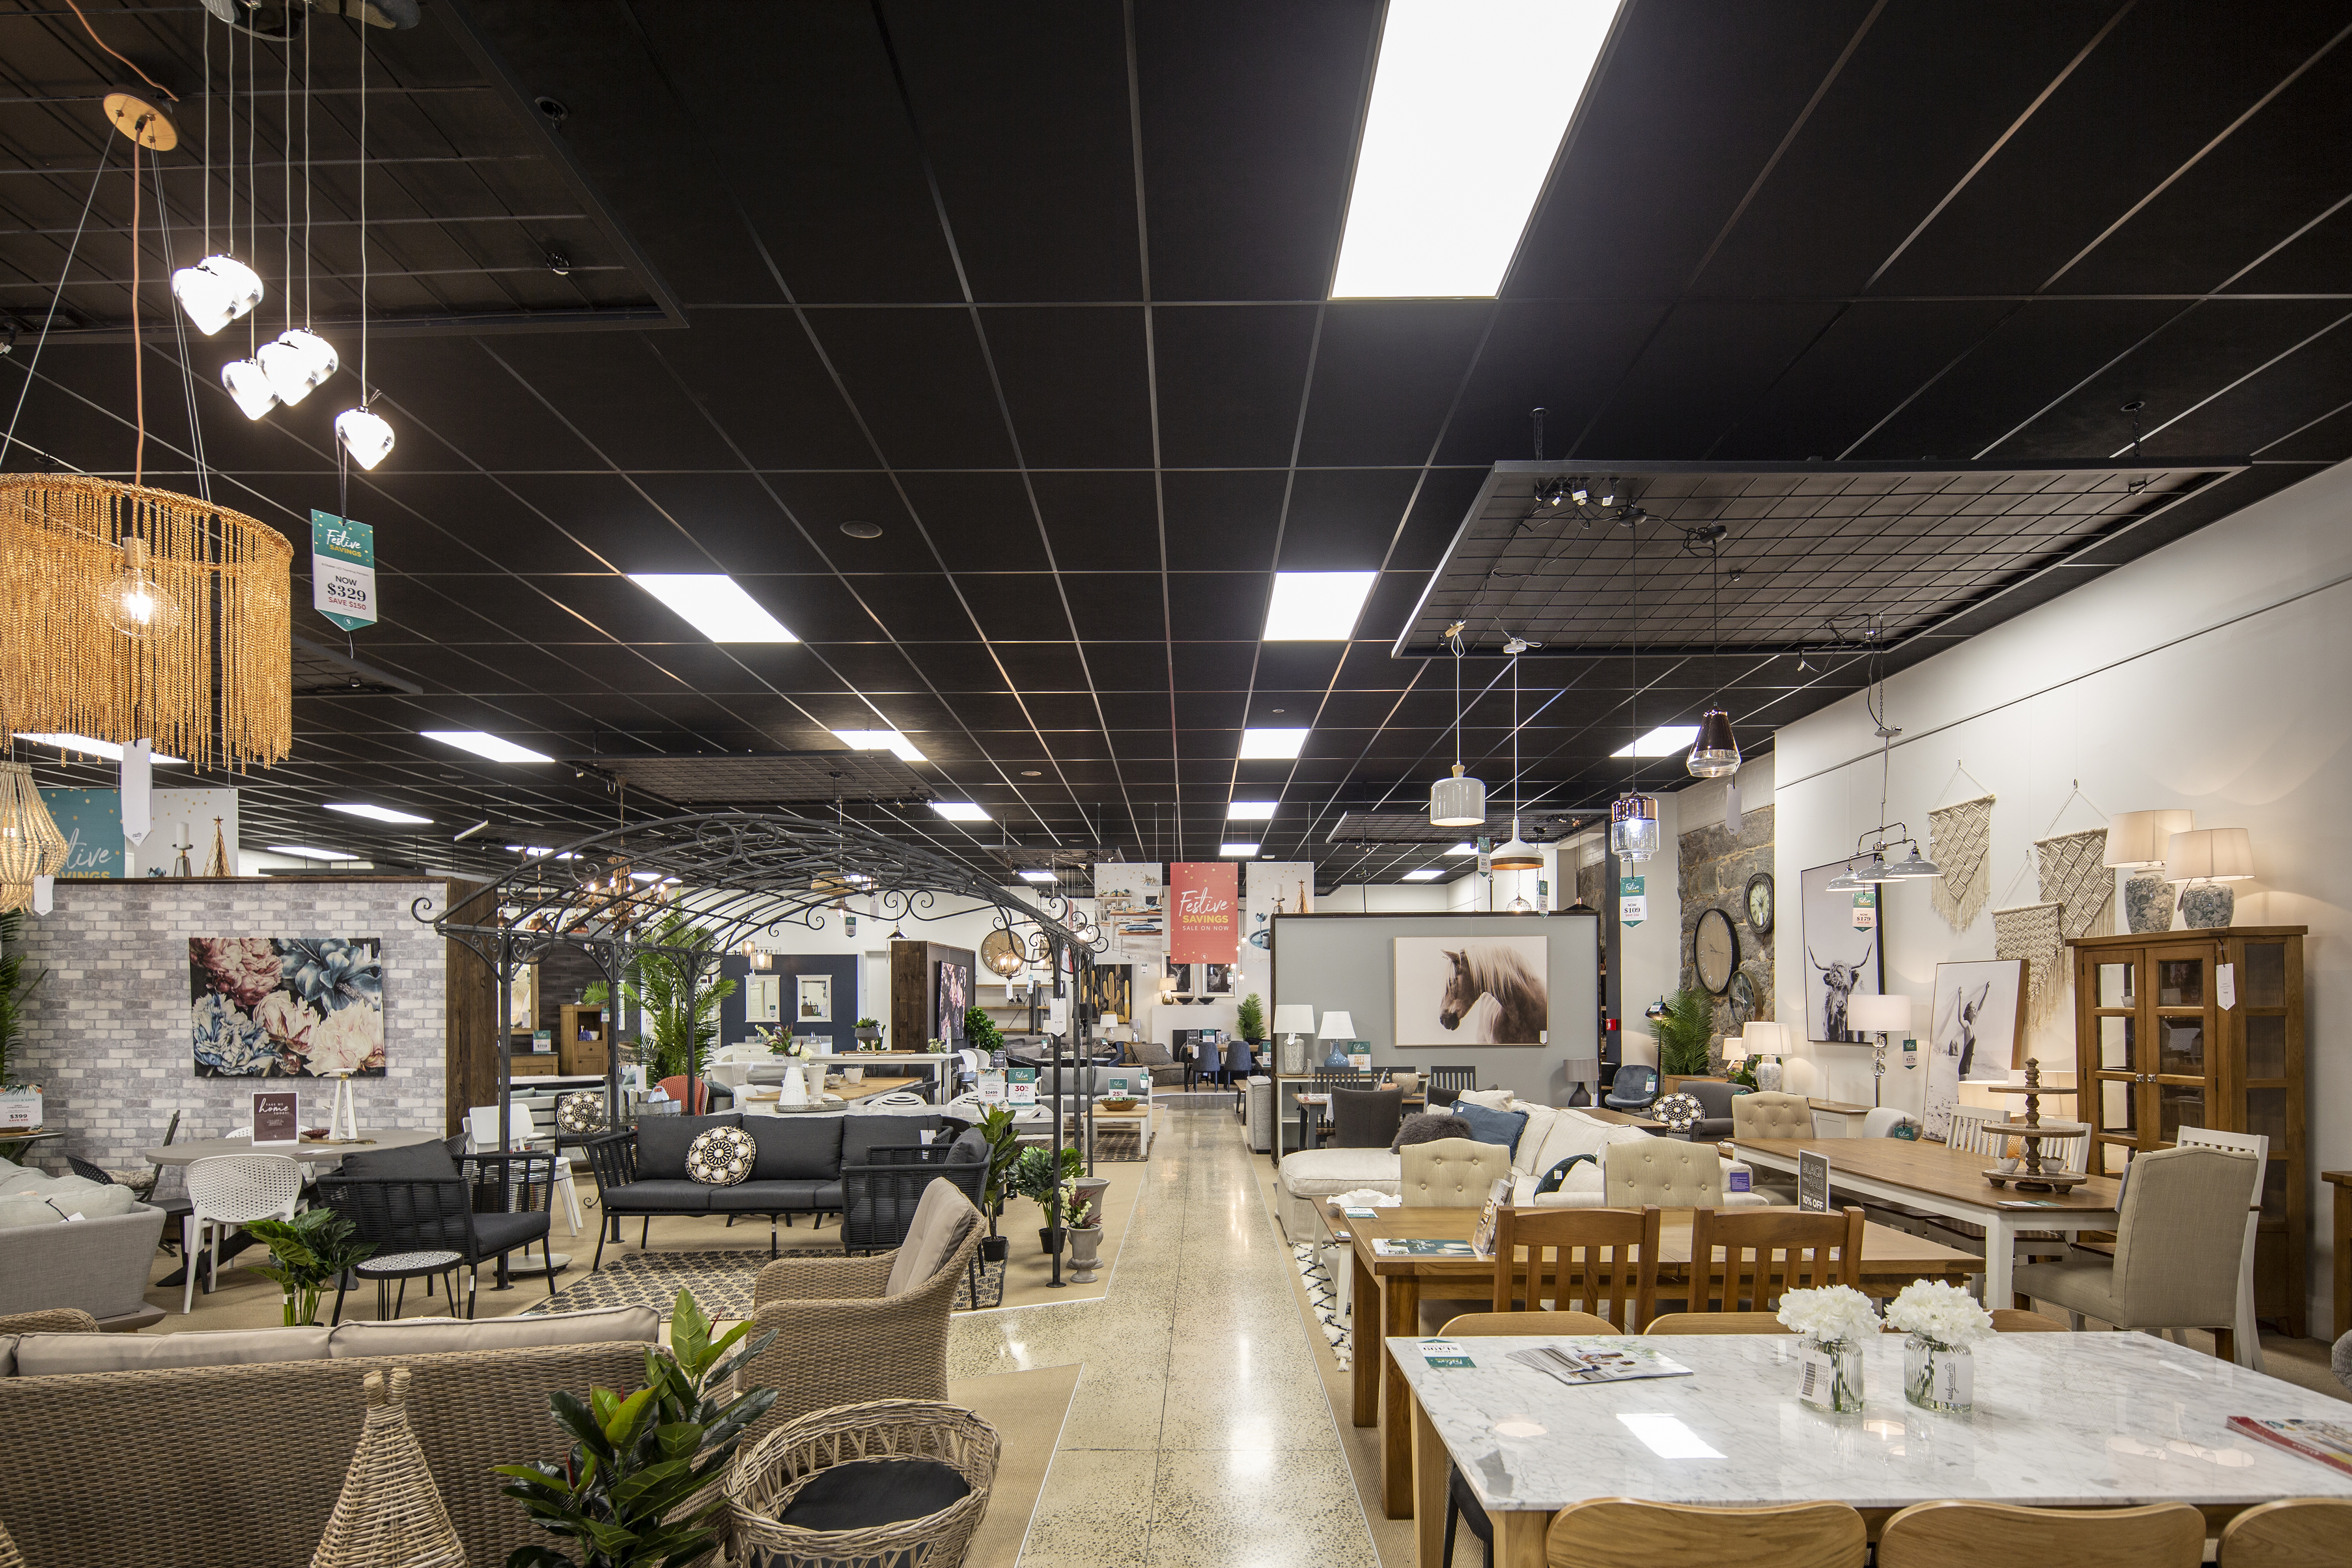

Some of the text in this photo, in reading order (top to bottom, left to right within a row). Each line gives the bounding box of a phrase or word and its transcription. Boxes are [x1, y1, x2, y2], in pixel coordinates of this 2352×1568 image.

[326, 529, 362, 549] Festive
[329, 544, 362, 557] SAVINGS
[336, 575, 357, 586] NOW
[327, 582, 366, 602] $329
[328, 597, 347, 606] SAVE
[349, 601, 366, 610] $150
[66, 828, 112, 869] tive
[1625, 882, 1640, 891] Festive
[1179, 886, 1229, 917] Festive
[1182, 915, 1228, 923] SAVINGS
[259, 1098, 290, 1113] home
[1802, 1161, 1823, 1179] BLACK
[1808, 1176, 1823, 1191] SALE
[1802, 1195, 1823, 1209] 10% OFF
